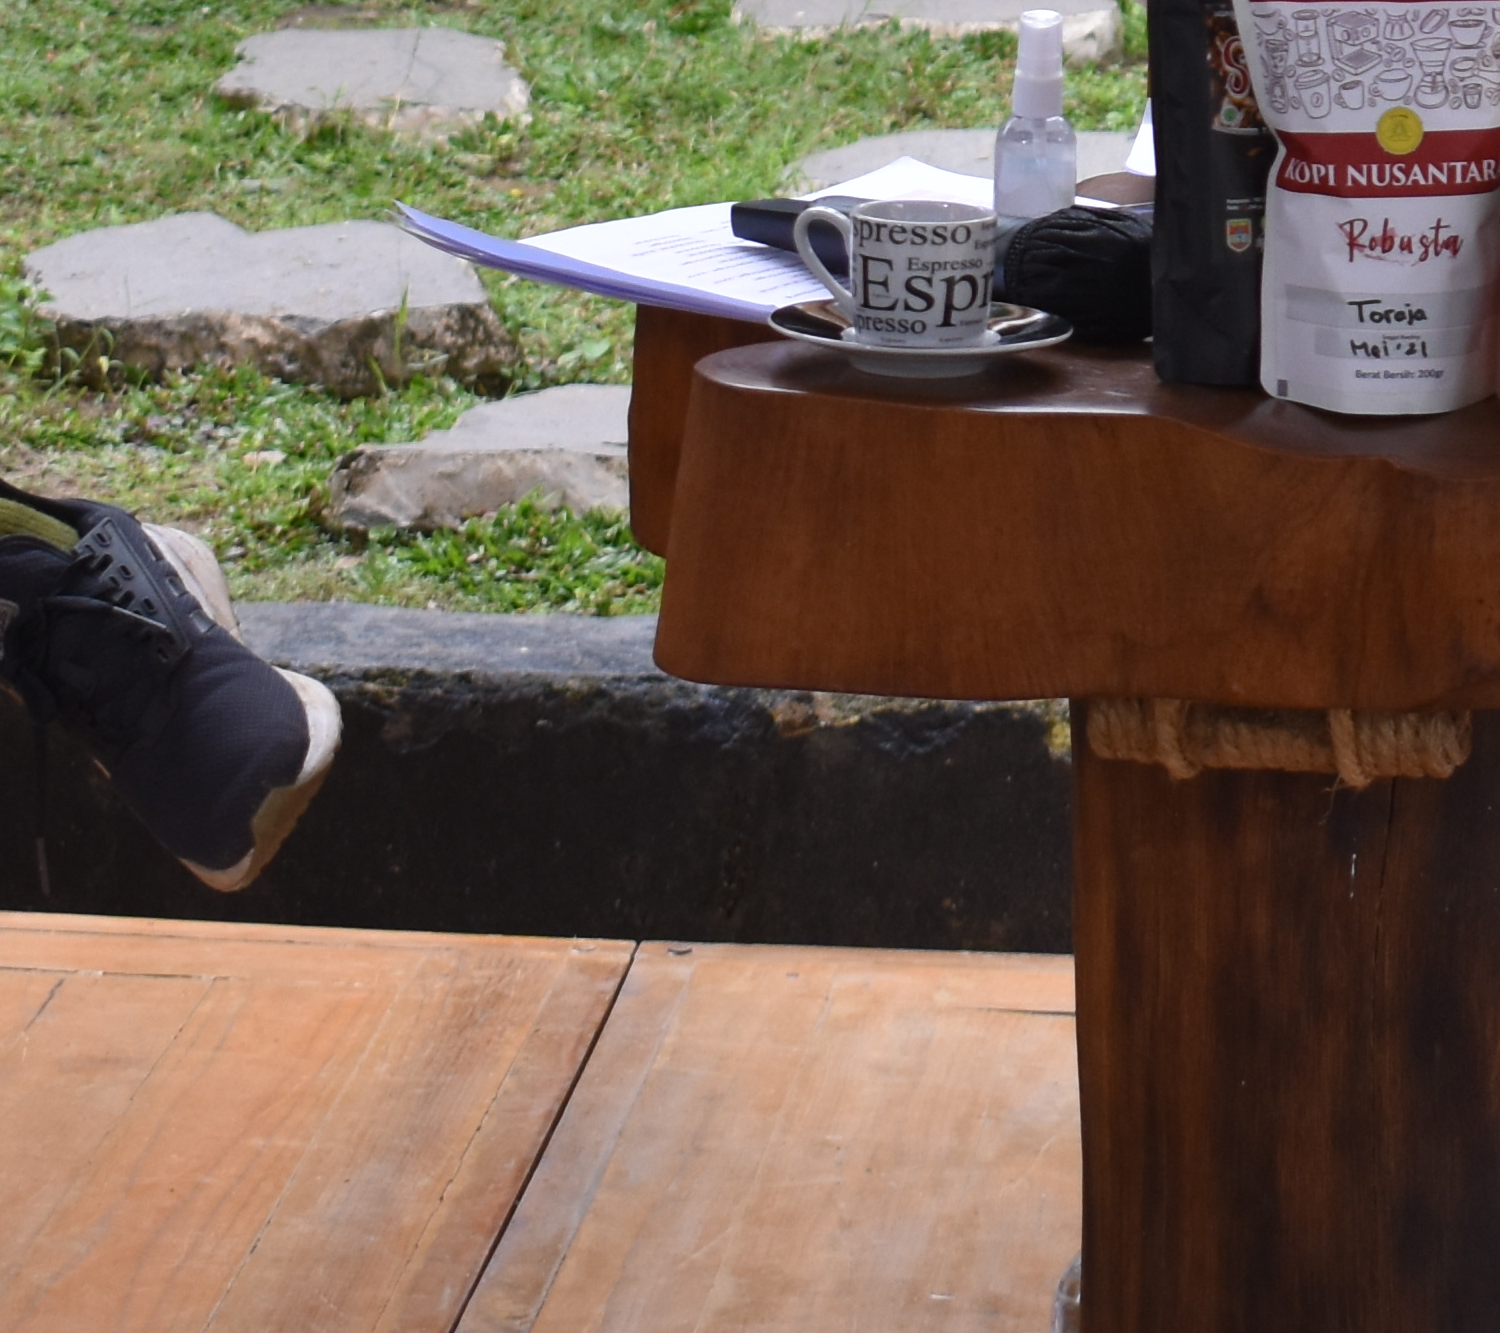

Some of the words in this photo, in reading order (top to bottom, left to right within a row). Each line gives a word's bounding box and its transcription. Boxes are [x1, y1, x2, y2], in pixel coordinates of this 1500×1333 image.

[1285, 157, 1335, 187] KOPI
[1337, 217, 1464, 263] Robusta
[906, 256, 984, 275] Espresso
[1347, 299, 1428, 326] Toraja
[1350, 339, 1389, 358] Mei
[1355, 369, 1381, 379] Berat
[1383, 369, 1415, 379] Bersih:
